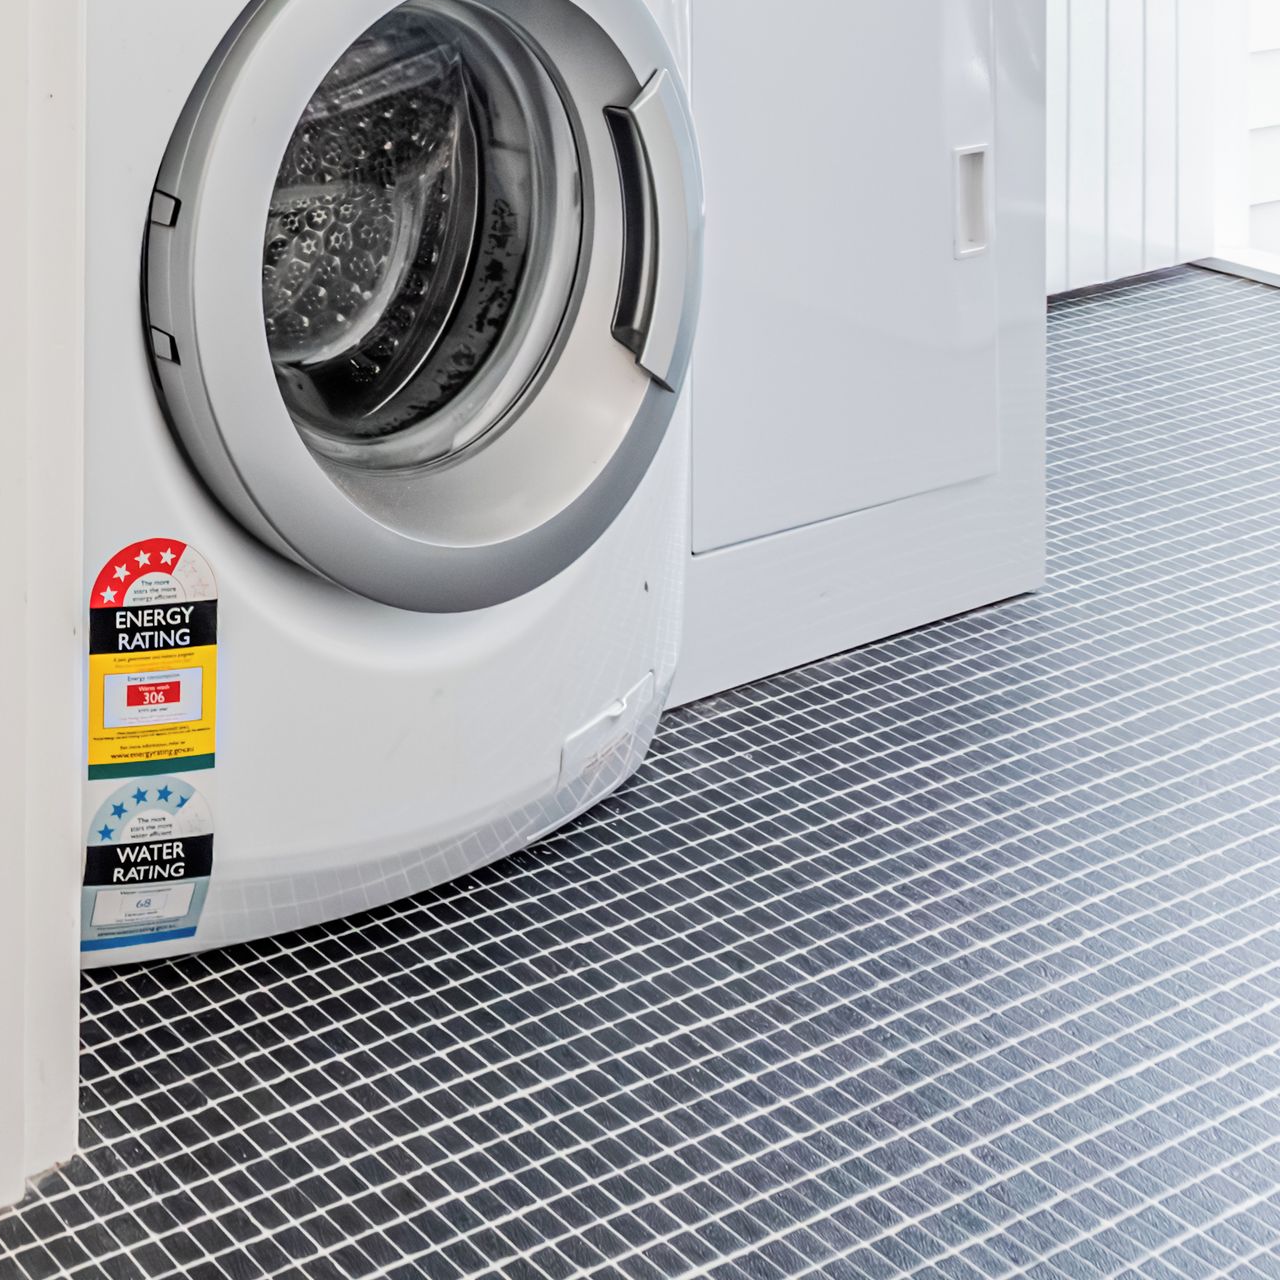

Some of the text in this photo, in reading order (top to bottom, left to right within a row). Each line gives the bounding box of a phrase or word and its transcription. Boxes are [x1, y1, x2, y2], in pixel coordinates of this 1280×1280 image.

[115, 606, 194, 629] ENERGY
[118, 628, 190, 650] RATING
[142, 692, 165, 704] 306
[116, 842, 186, 864] WATER
[112, 862, 186, 882] RATING
